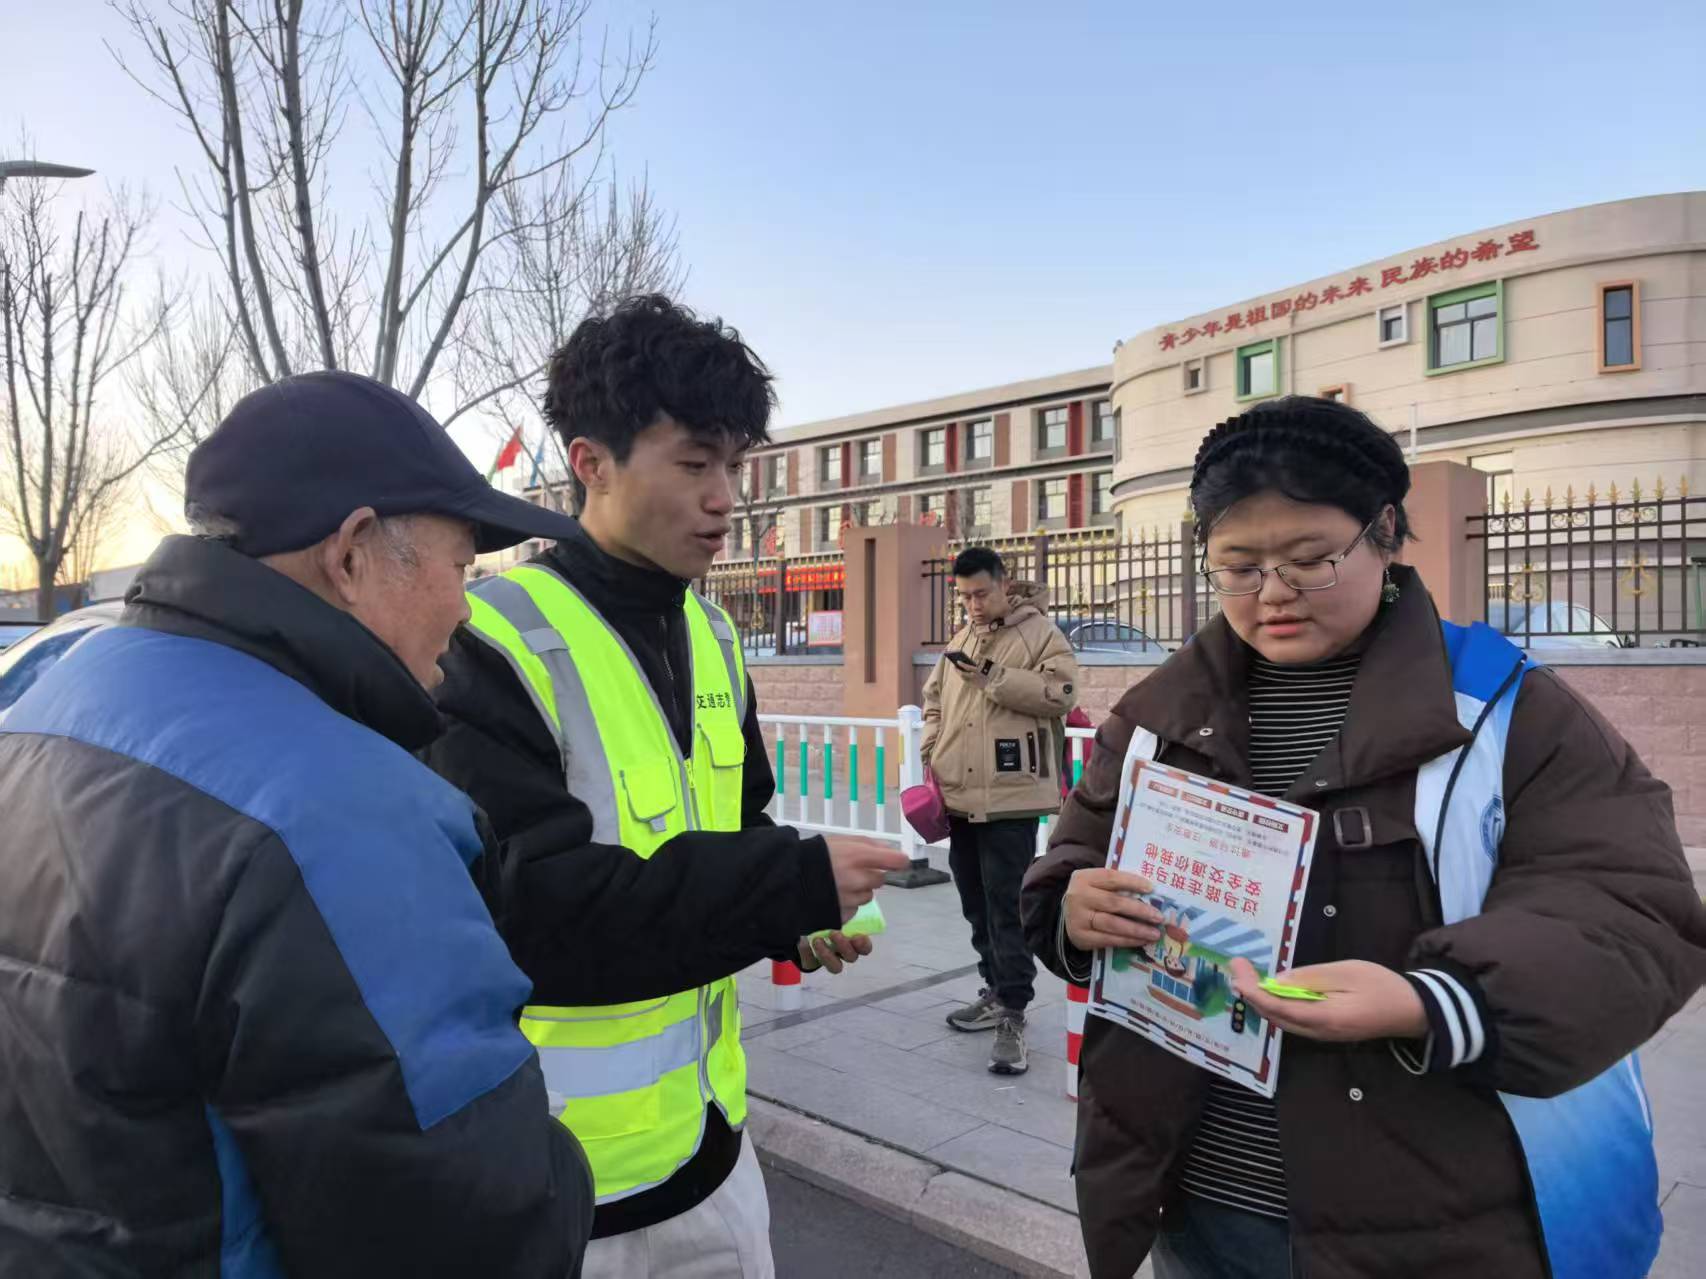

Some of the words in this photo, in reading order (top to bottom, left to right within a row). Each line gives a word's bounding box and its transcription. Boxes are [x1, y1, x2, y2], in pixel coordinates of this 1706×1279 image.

[1158, 275, 1373, 351] 青少年是祖国的未来
[1381, 230, 1540, 289] 民族的希望
[1141, 860, 1259, 918] 过马路走斑马线
[1144, 843, 1262, 897] 安全交通你我他
